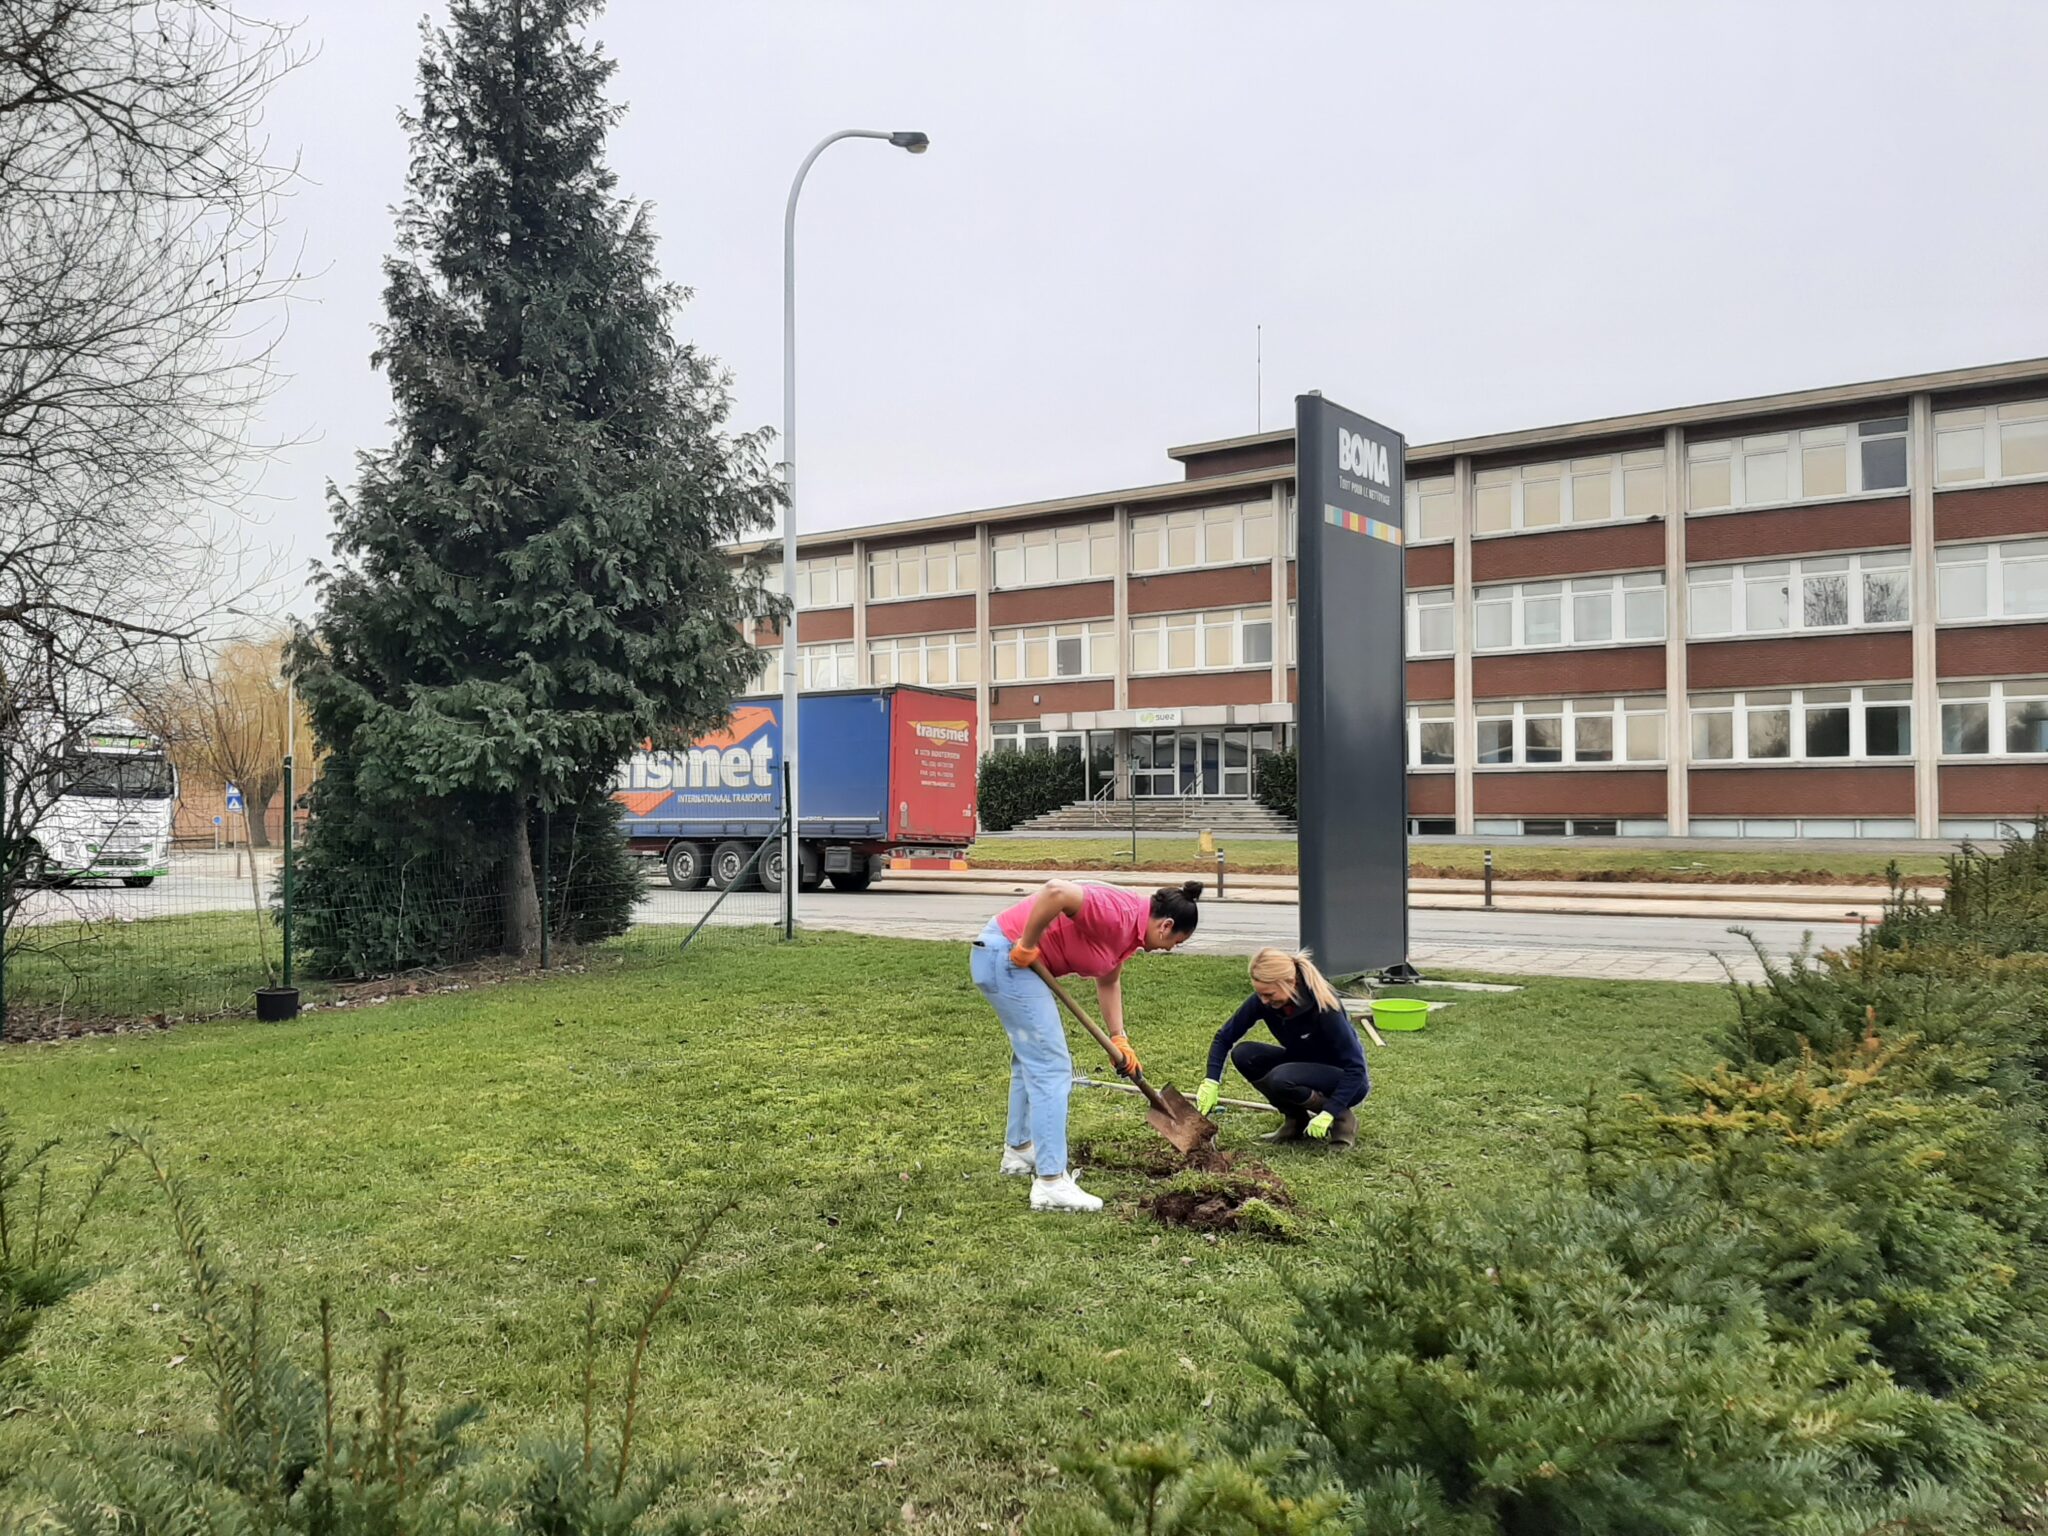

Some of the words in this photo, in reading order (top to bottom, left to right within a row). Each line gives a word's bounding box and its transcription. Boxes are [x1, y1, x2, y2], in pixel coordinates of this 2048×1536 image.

[1339, 427, 1390, 488] BOMA
[916, 722, 969, 742] transmet
[607, 733, 774, 789] nsmet
[732, 793, 772, 804] TRANSPORT
